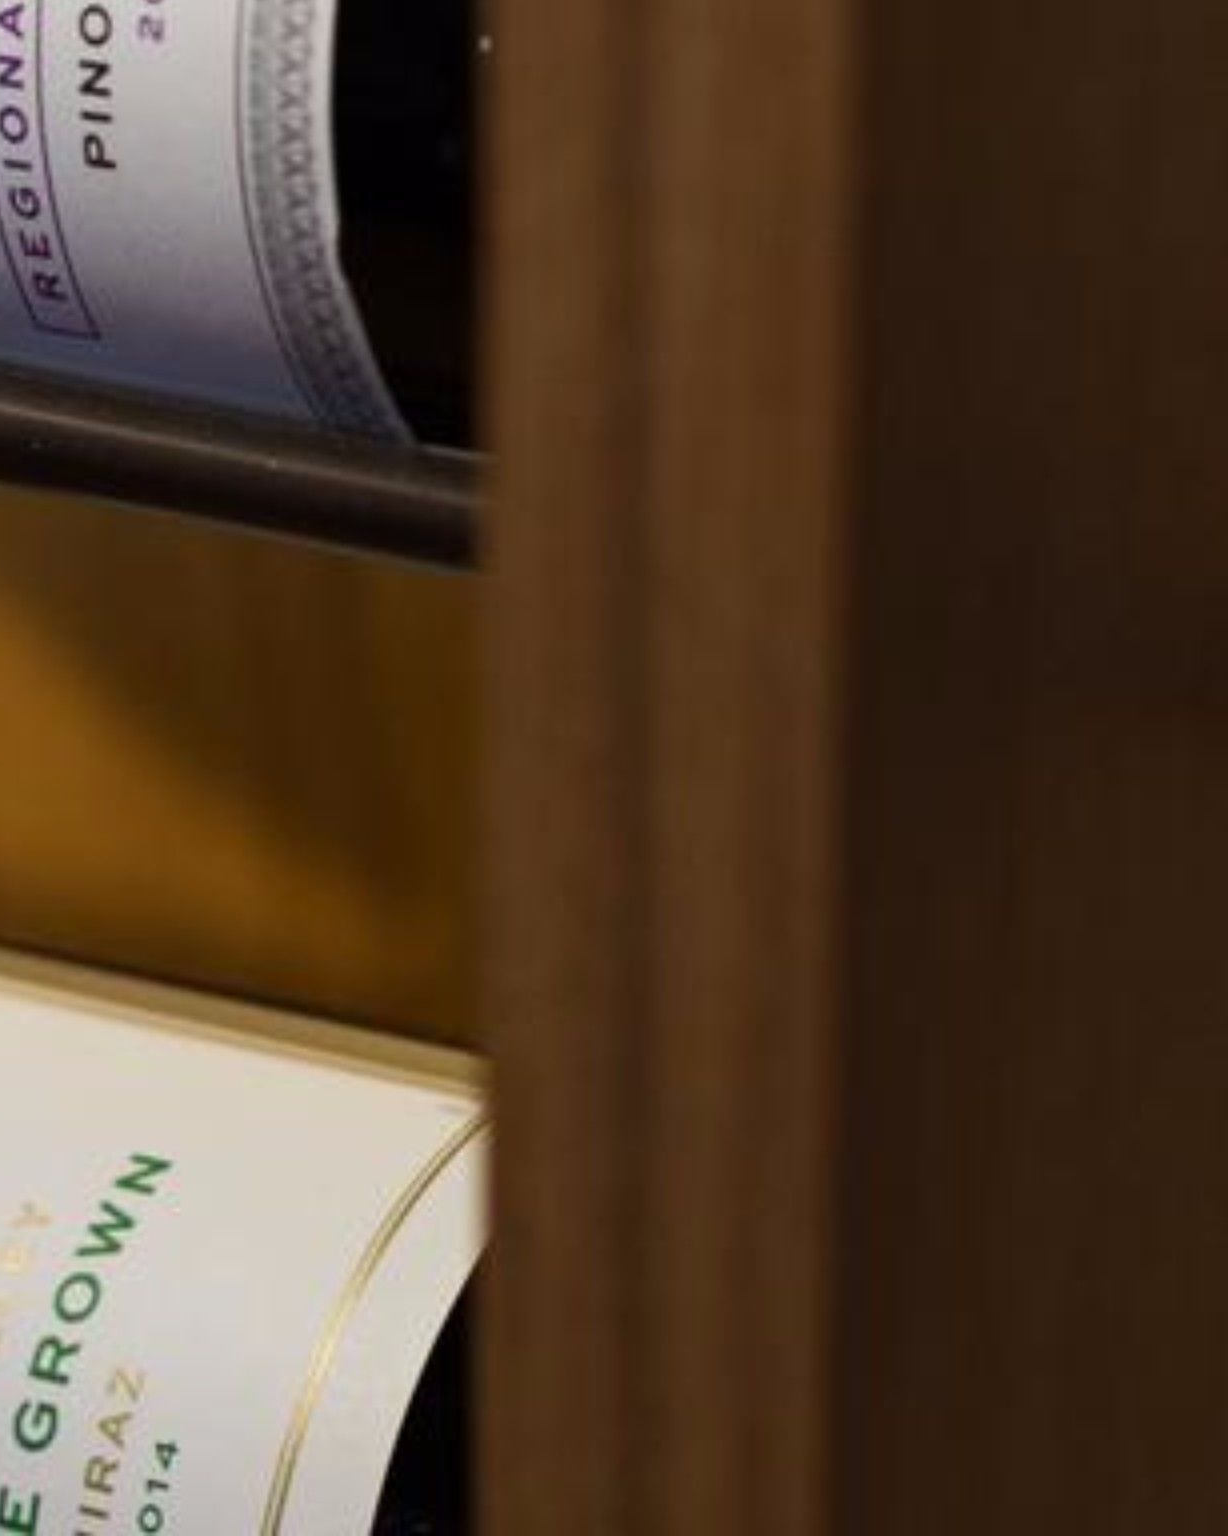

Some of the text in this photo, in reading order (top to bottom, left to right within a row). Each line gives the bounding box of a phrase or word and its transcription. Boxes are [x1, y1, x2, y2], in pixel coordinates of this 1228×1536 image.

[13, 1152, 174, 1452] GROWN
[75, 1367, 146, 1536] IRAZ
[136, 1439, 180, 1534] 014
